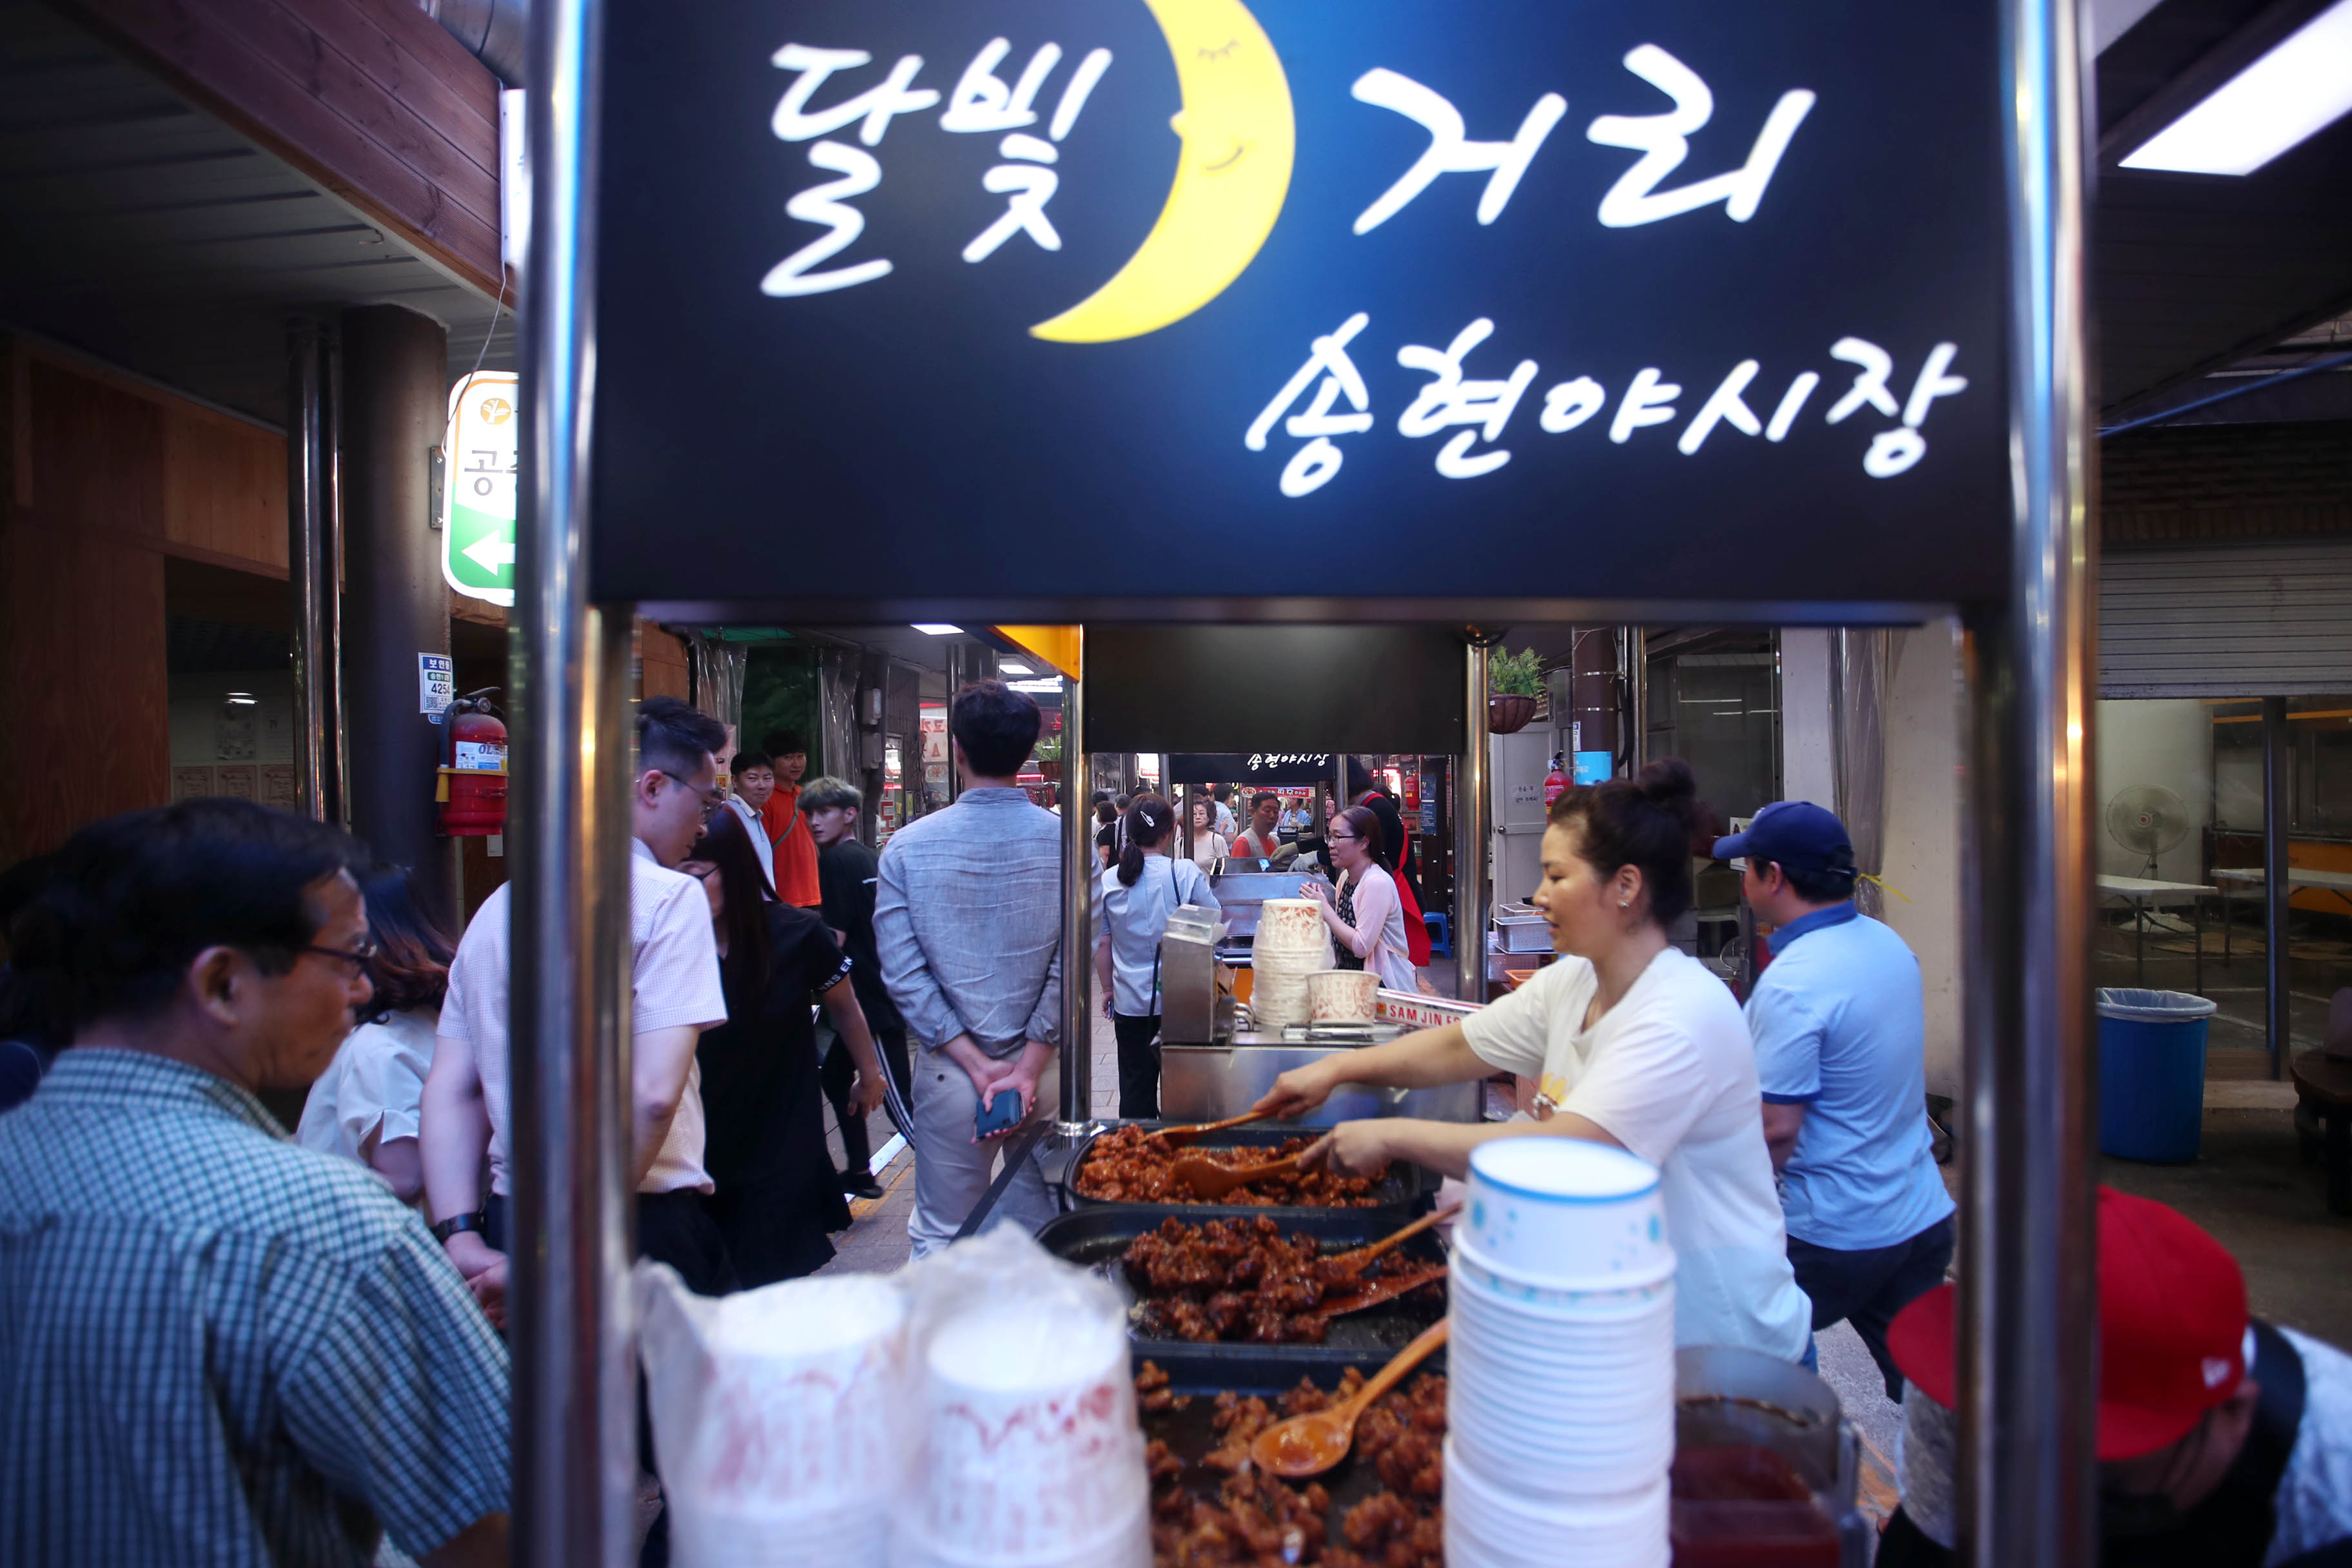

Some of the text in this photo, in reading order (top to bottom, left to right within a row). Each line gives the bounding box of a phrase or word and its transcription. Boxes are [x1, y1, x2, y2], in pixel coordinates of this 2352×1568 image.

[761, 37, 1817, 298] 달빛 거리
[1245, 312, 1968, 498] 송현야시장
[431, 682, 451, 695] 4254
[1389, 1004, 1418, 1022] SAM
[1420, 1010, 1442, 1026] JIN
